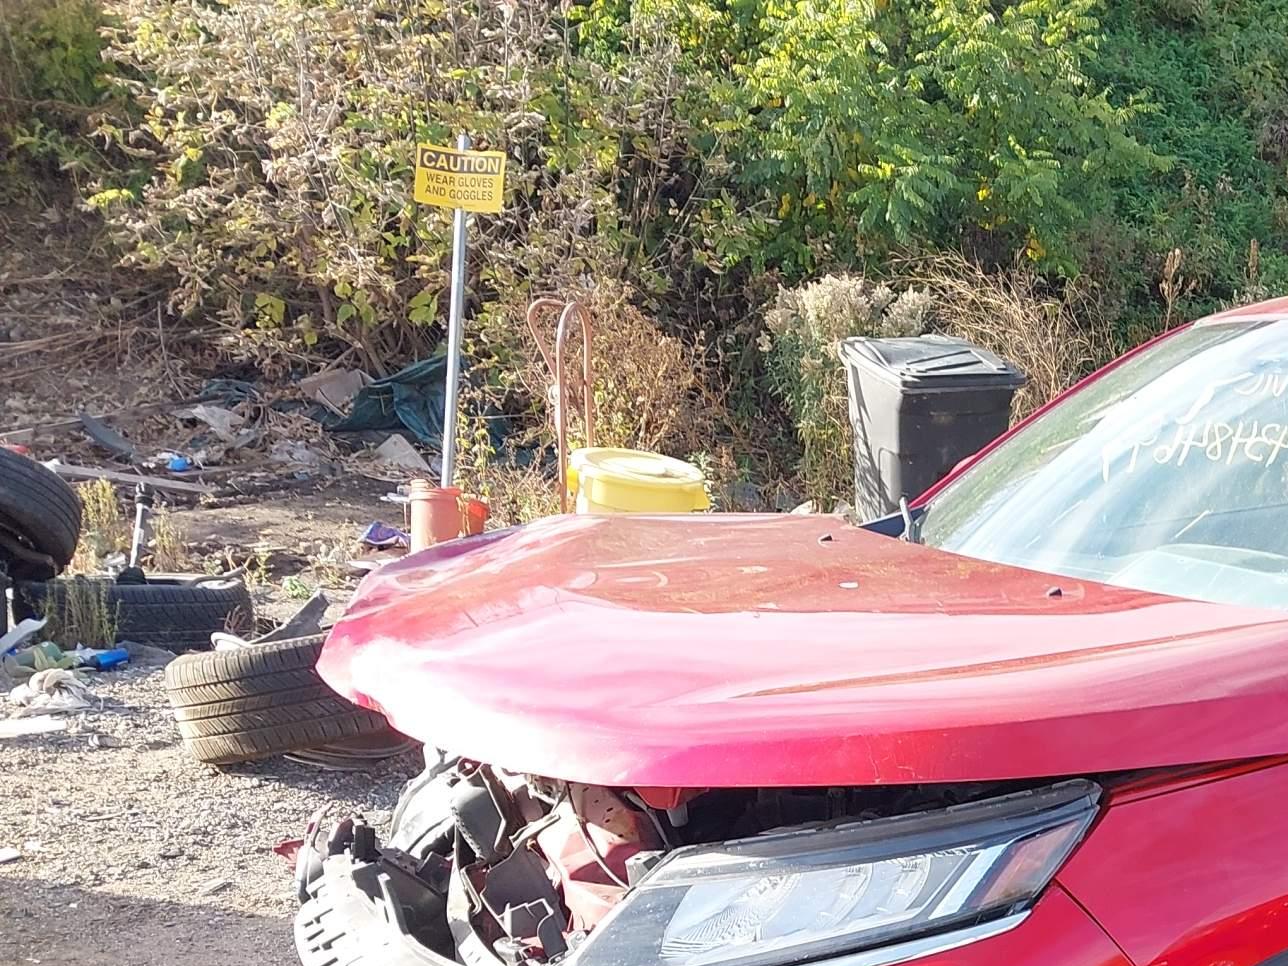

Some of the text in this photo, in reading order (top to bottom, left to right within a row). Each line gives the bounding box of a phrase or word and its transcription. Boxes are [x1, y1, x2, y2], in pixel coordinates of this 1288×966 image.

[423, 151, 500, 173] CAUTION
[426, 172, 494, 189] WEAR GLOVES
[425, 184, 493, 201] AND GOGGLES
